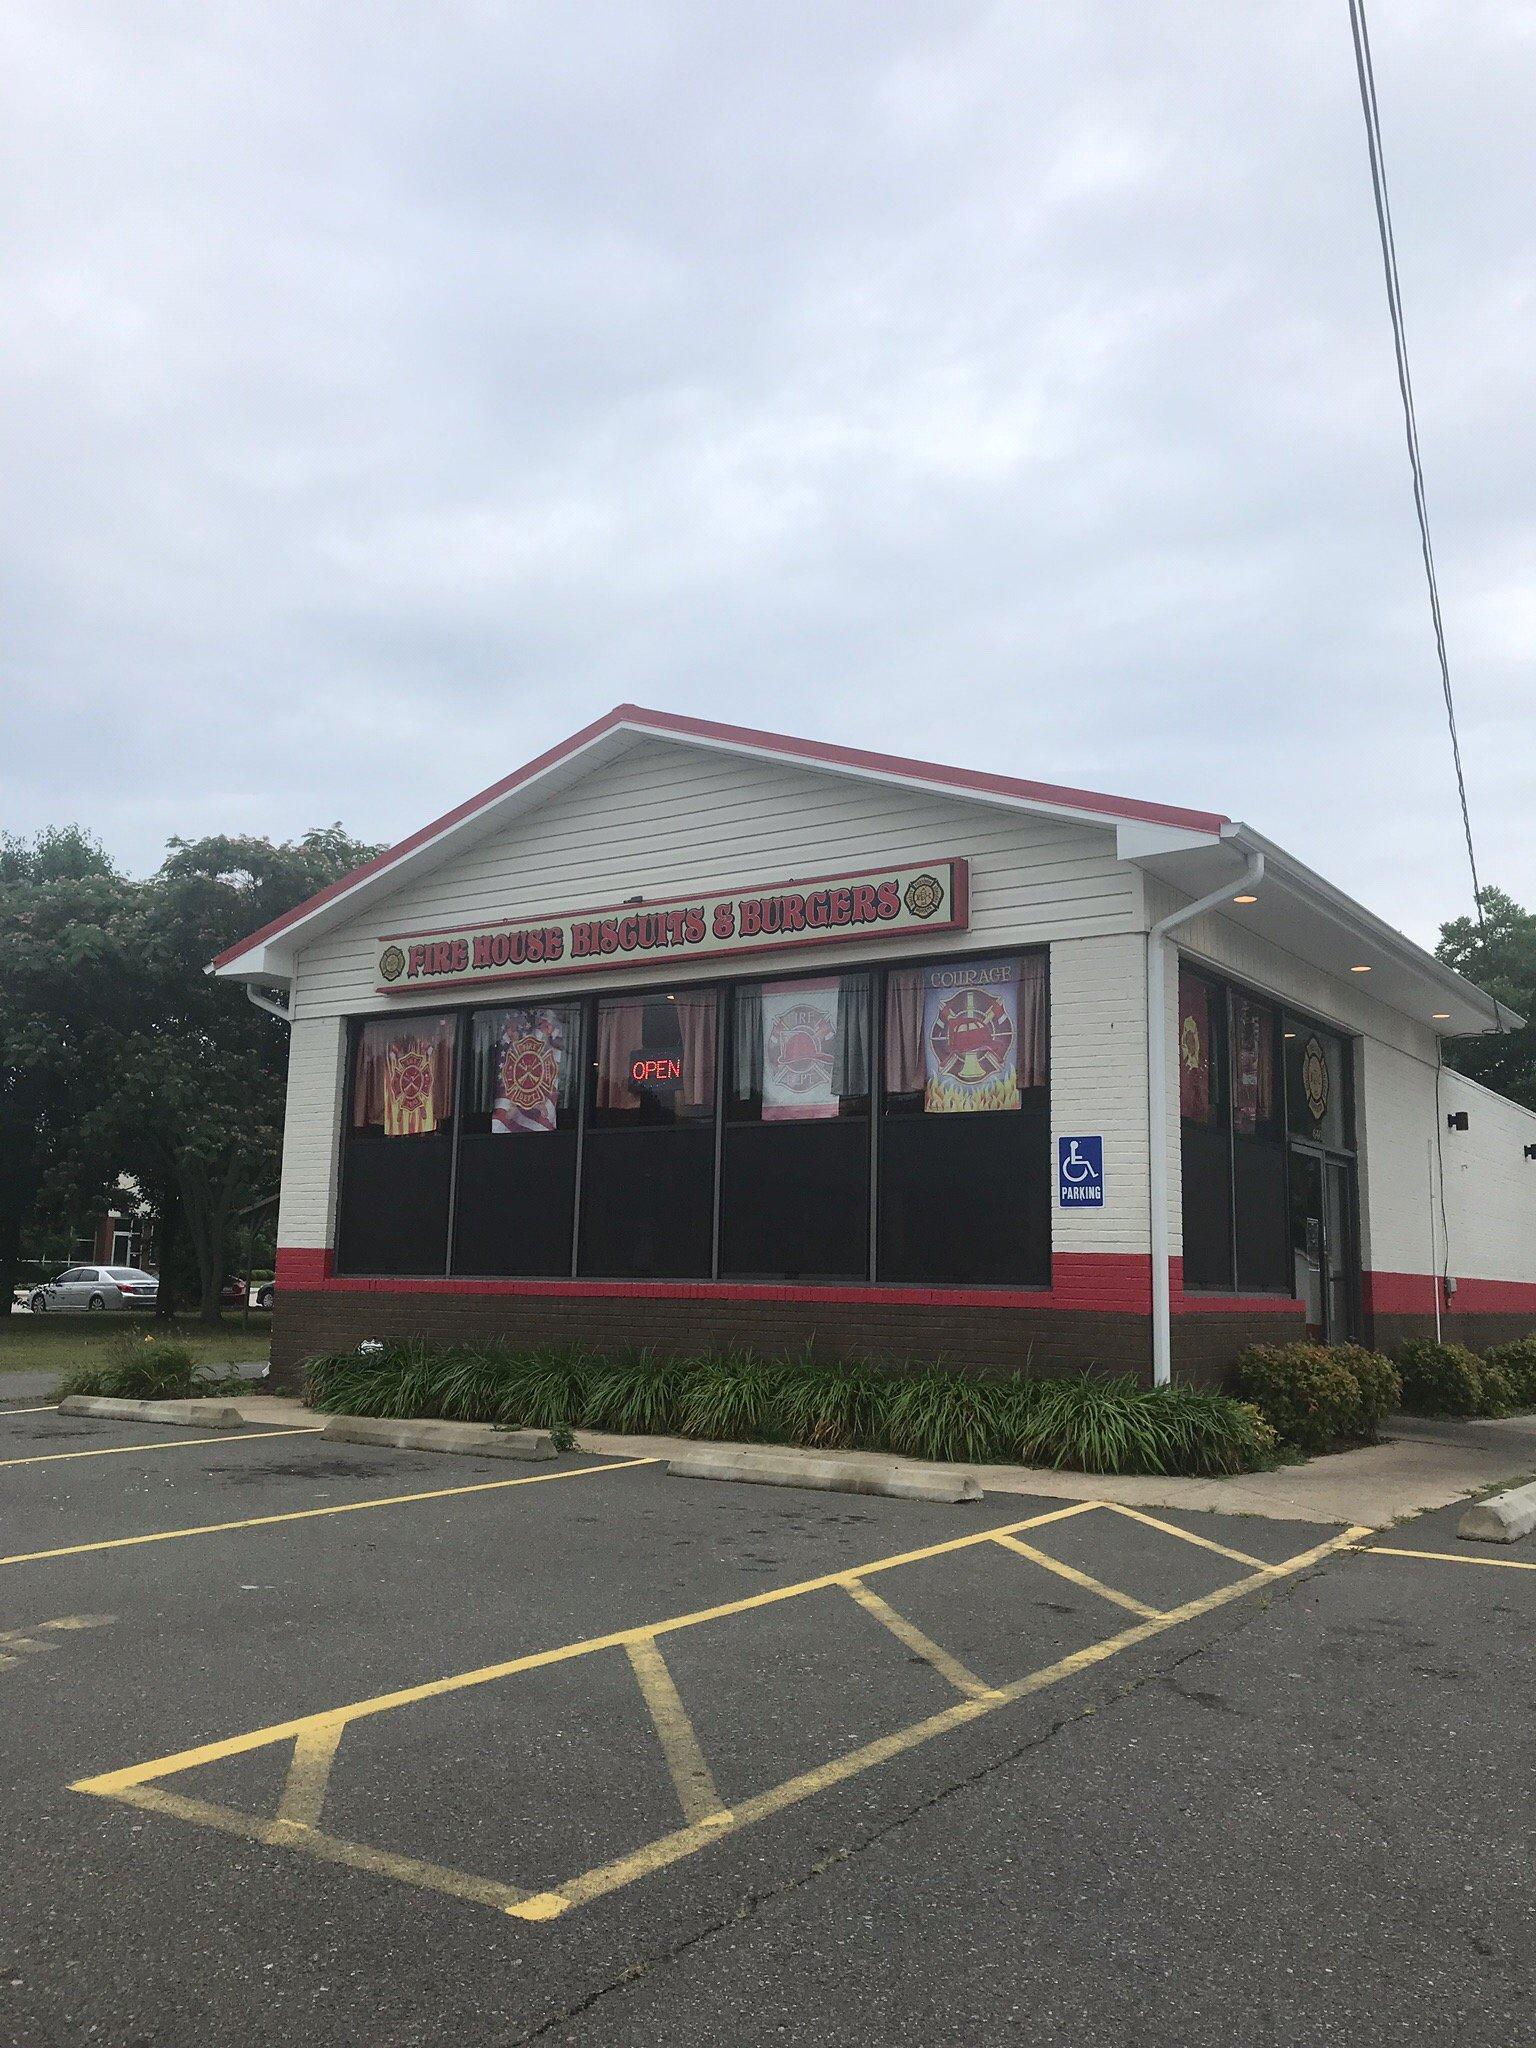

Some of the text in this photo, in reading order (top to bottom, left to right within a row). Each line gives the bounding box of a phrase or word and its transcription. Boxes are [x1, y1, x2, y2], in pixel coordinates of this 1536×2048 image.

[407, 939, 468, 979] FIRE
[472, 926, 564, 969] HOUSE
[571, 907, 706, 958] BISCUITS
[713, 901, 735, 939] &
[739, 879, 901, 937] BURGERS
[930, 966, 1012, 987] COURAGE
[632, 1058, 681, 1081] OPEN
[1061, 1186, 1102, 1200] PARKING
